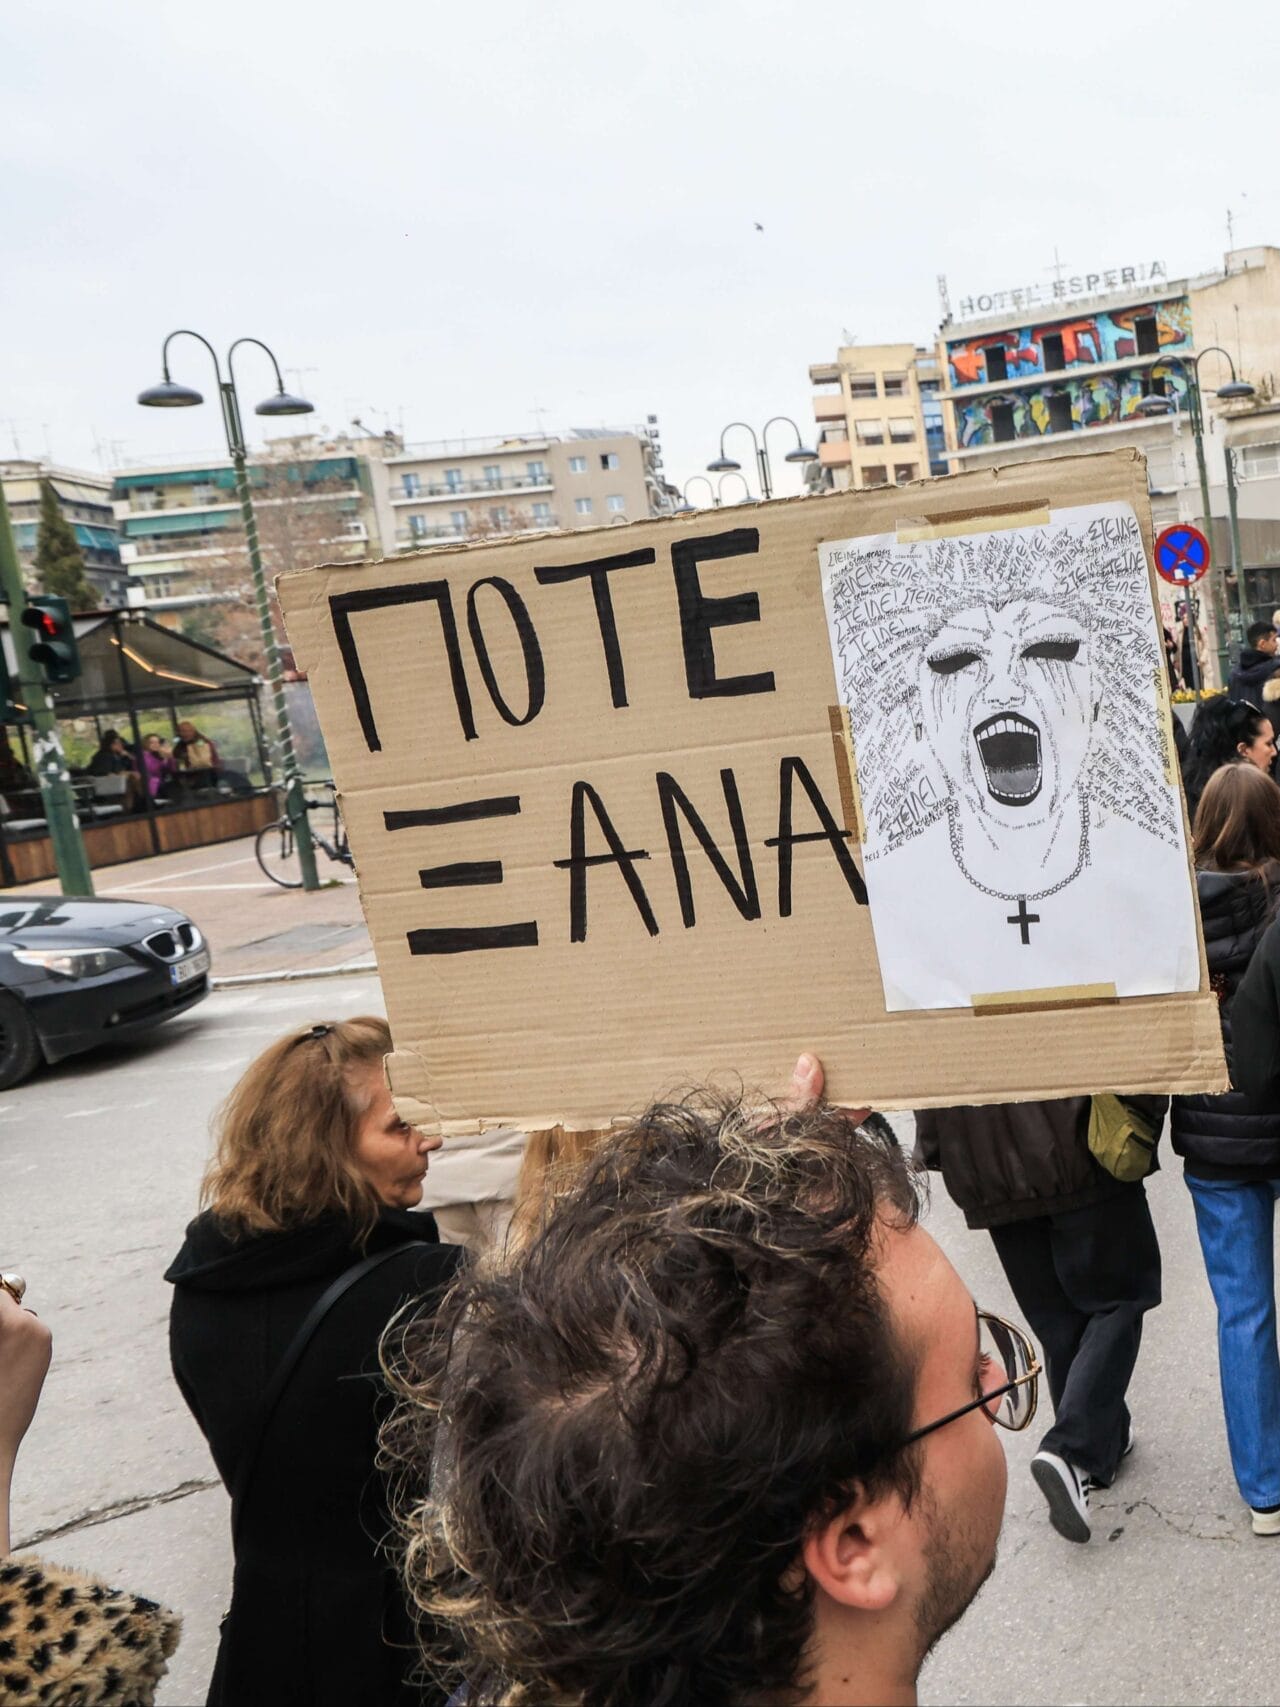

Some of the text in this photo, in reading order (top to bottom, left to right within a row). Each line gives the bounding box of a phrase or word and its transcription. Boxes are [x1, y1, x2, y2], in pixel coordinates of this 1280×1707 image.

[960, 287, 1042, 317] HOTEL
[1053, 260, 1166, 297] ESPERIA
[329, 527, 775, 752] ΠΟΤΕ
[383, 756, 868, 954] ΞΑΝΑ
